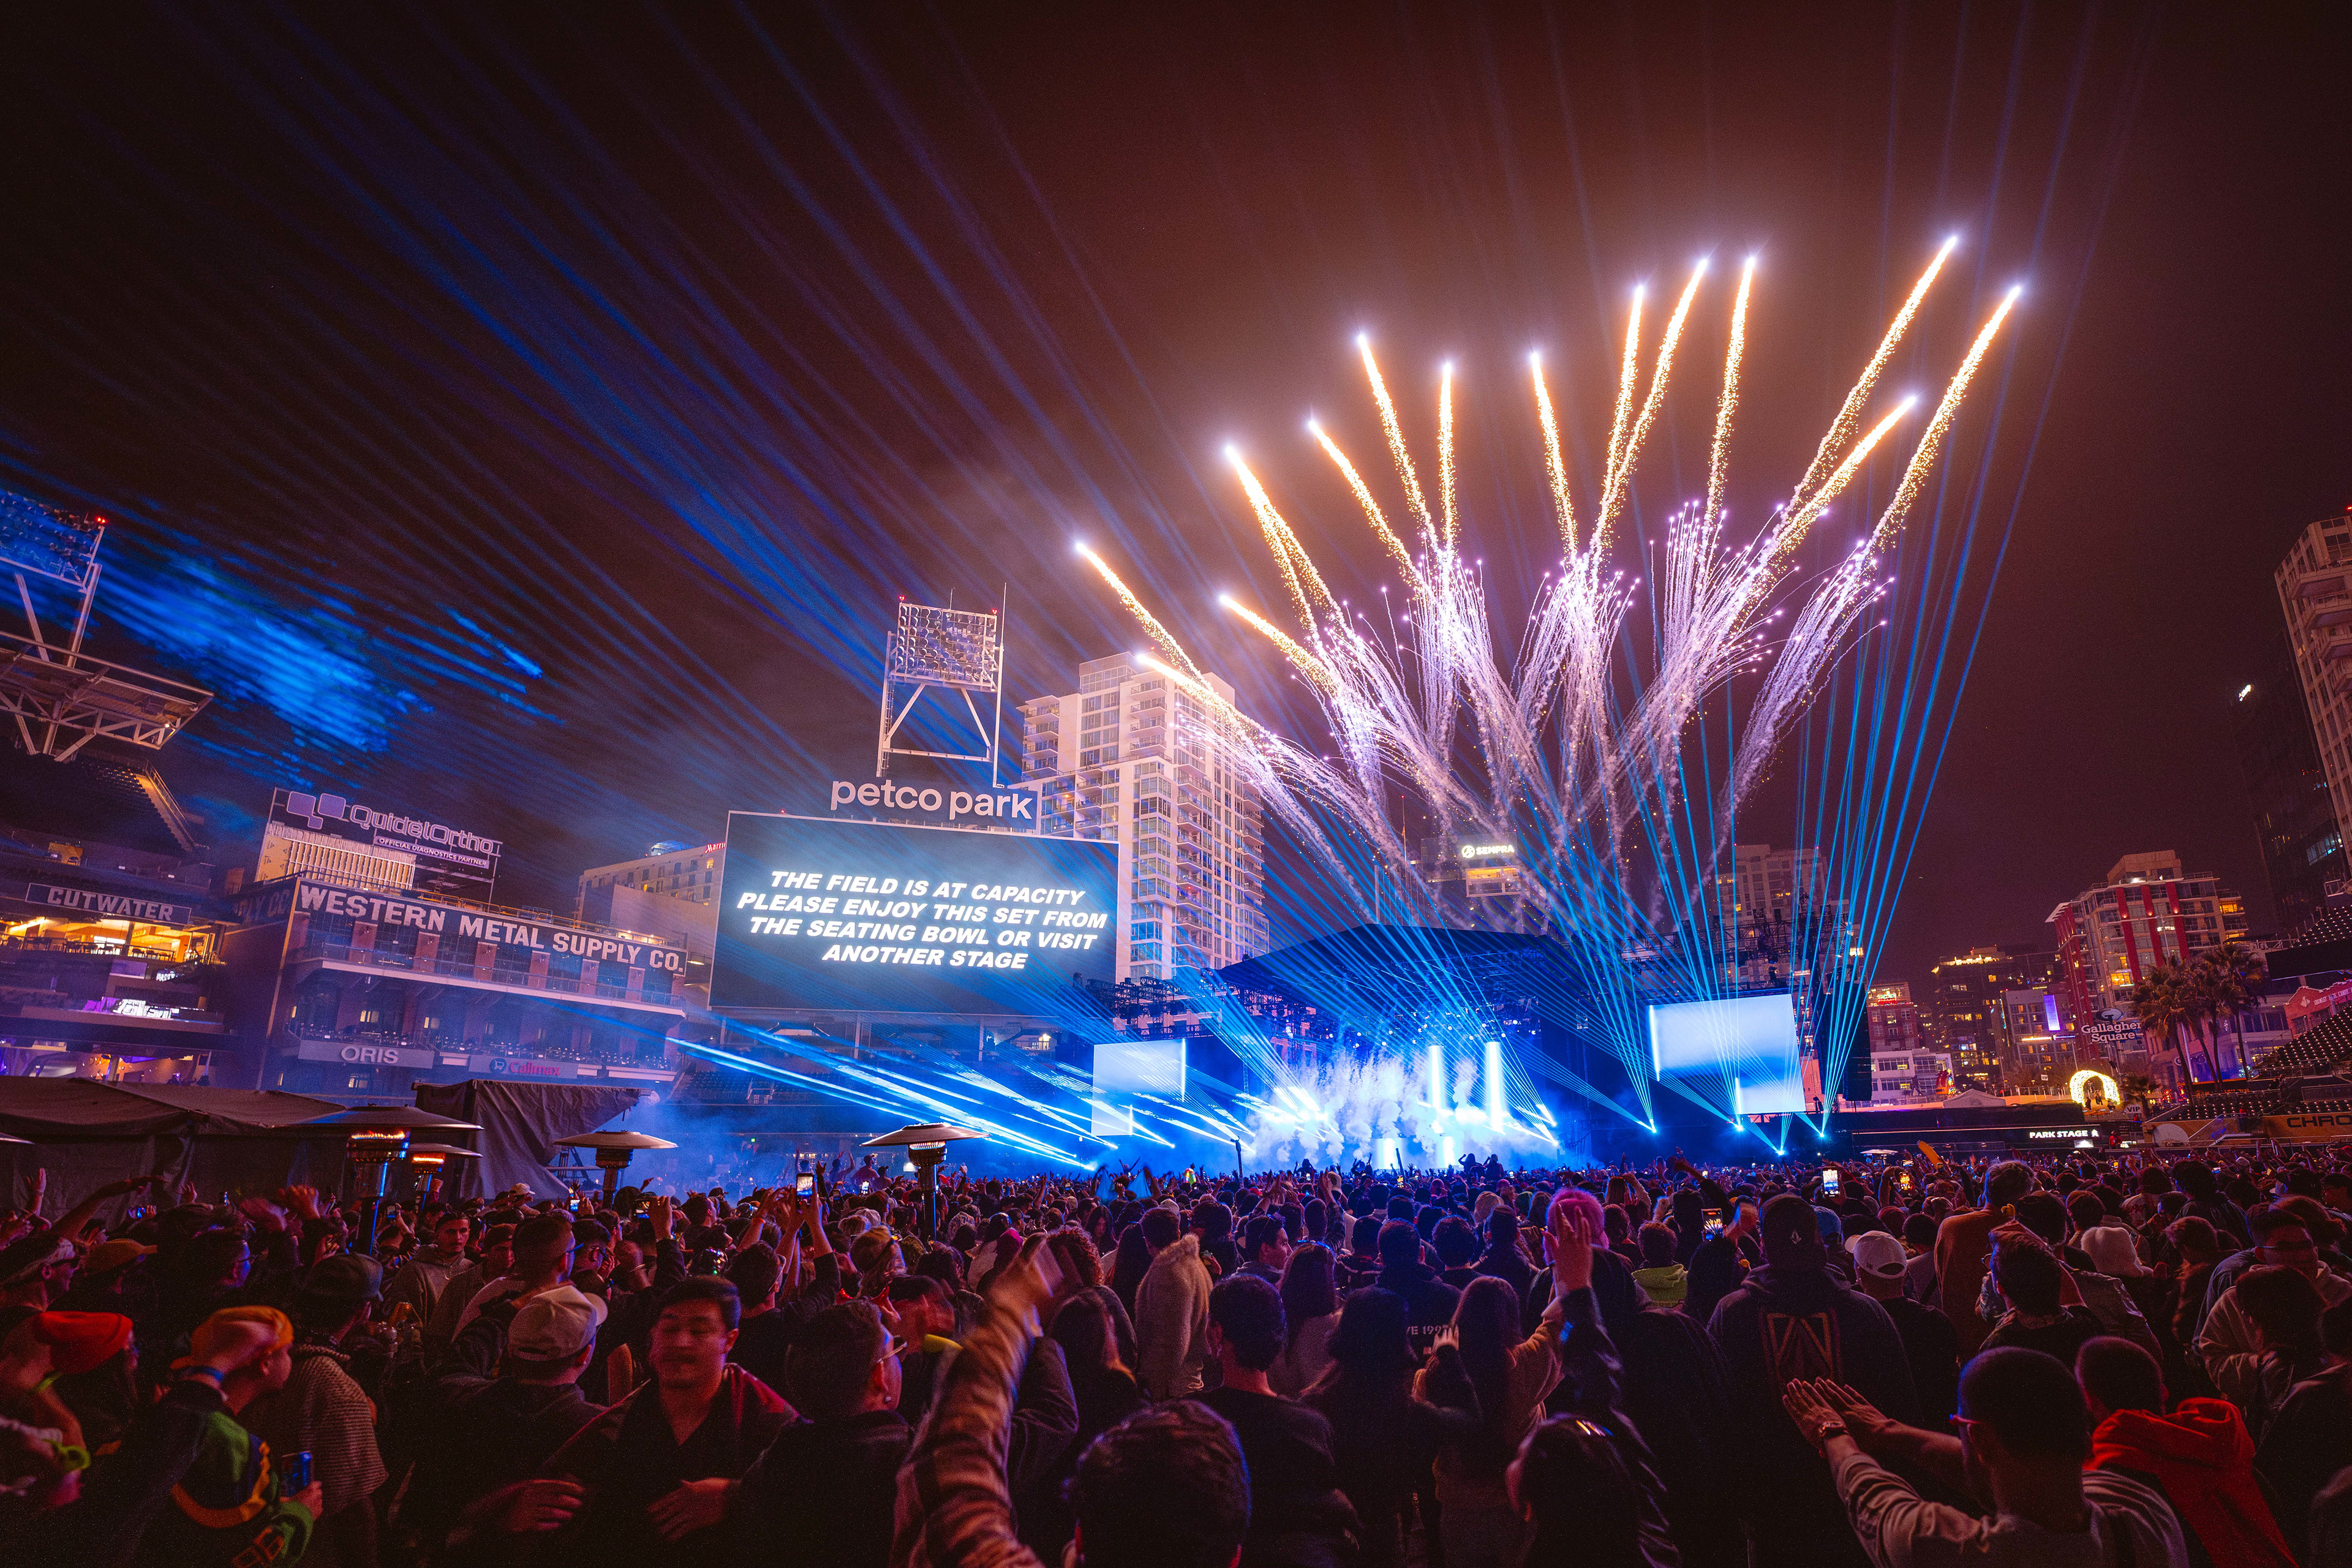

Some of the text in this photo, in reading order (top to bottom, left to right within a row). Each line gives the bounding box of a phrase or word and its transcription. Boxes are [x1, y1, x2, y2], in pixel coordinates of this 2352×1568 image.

[830, 779, 1033, 820] petco park
[350, 804, 494, 854] QuidelOrtho
[379, 838, 487, 867] OFFICIAL DIAGNOSTICS PARTNER
[1476, 845, 1515, 855] SEMPRA
[47, 888, 173, 921] CUTWATER
[771, 871, 1085, 905] THE FIELD IS AT CAPACITY
[736, 892, 1108, 929] PLEASE ENJOY THIS SET FROM
[301, 884, 684, 972] WESTERN METAL SUPPLY CO.
[750, 916, 1098, 949] THE SEATING BOWL OR VISIT
[822, 944, 1029, 969] ANOTHER STAGE
[2081, 1022, 2141, 1033] Gallagher
[2091, 1032, 2135, 1043] Square
[341, 1046, 398, 1064] ORIS
